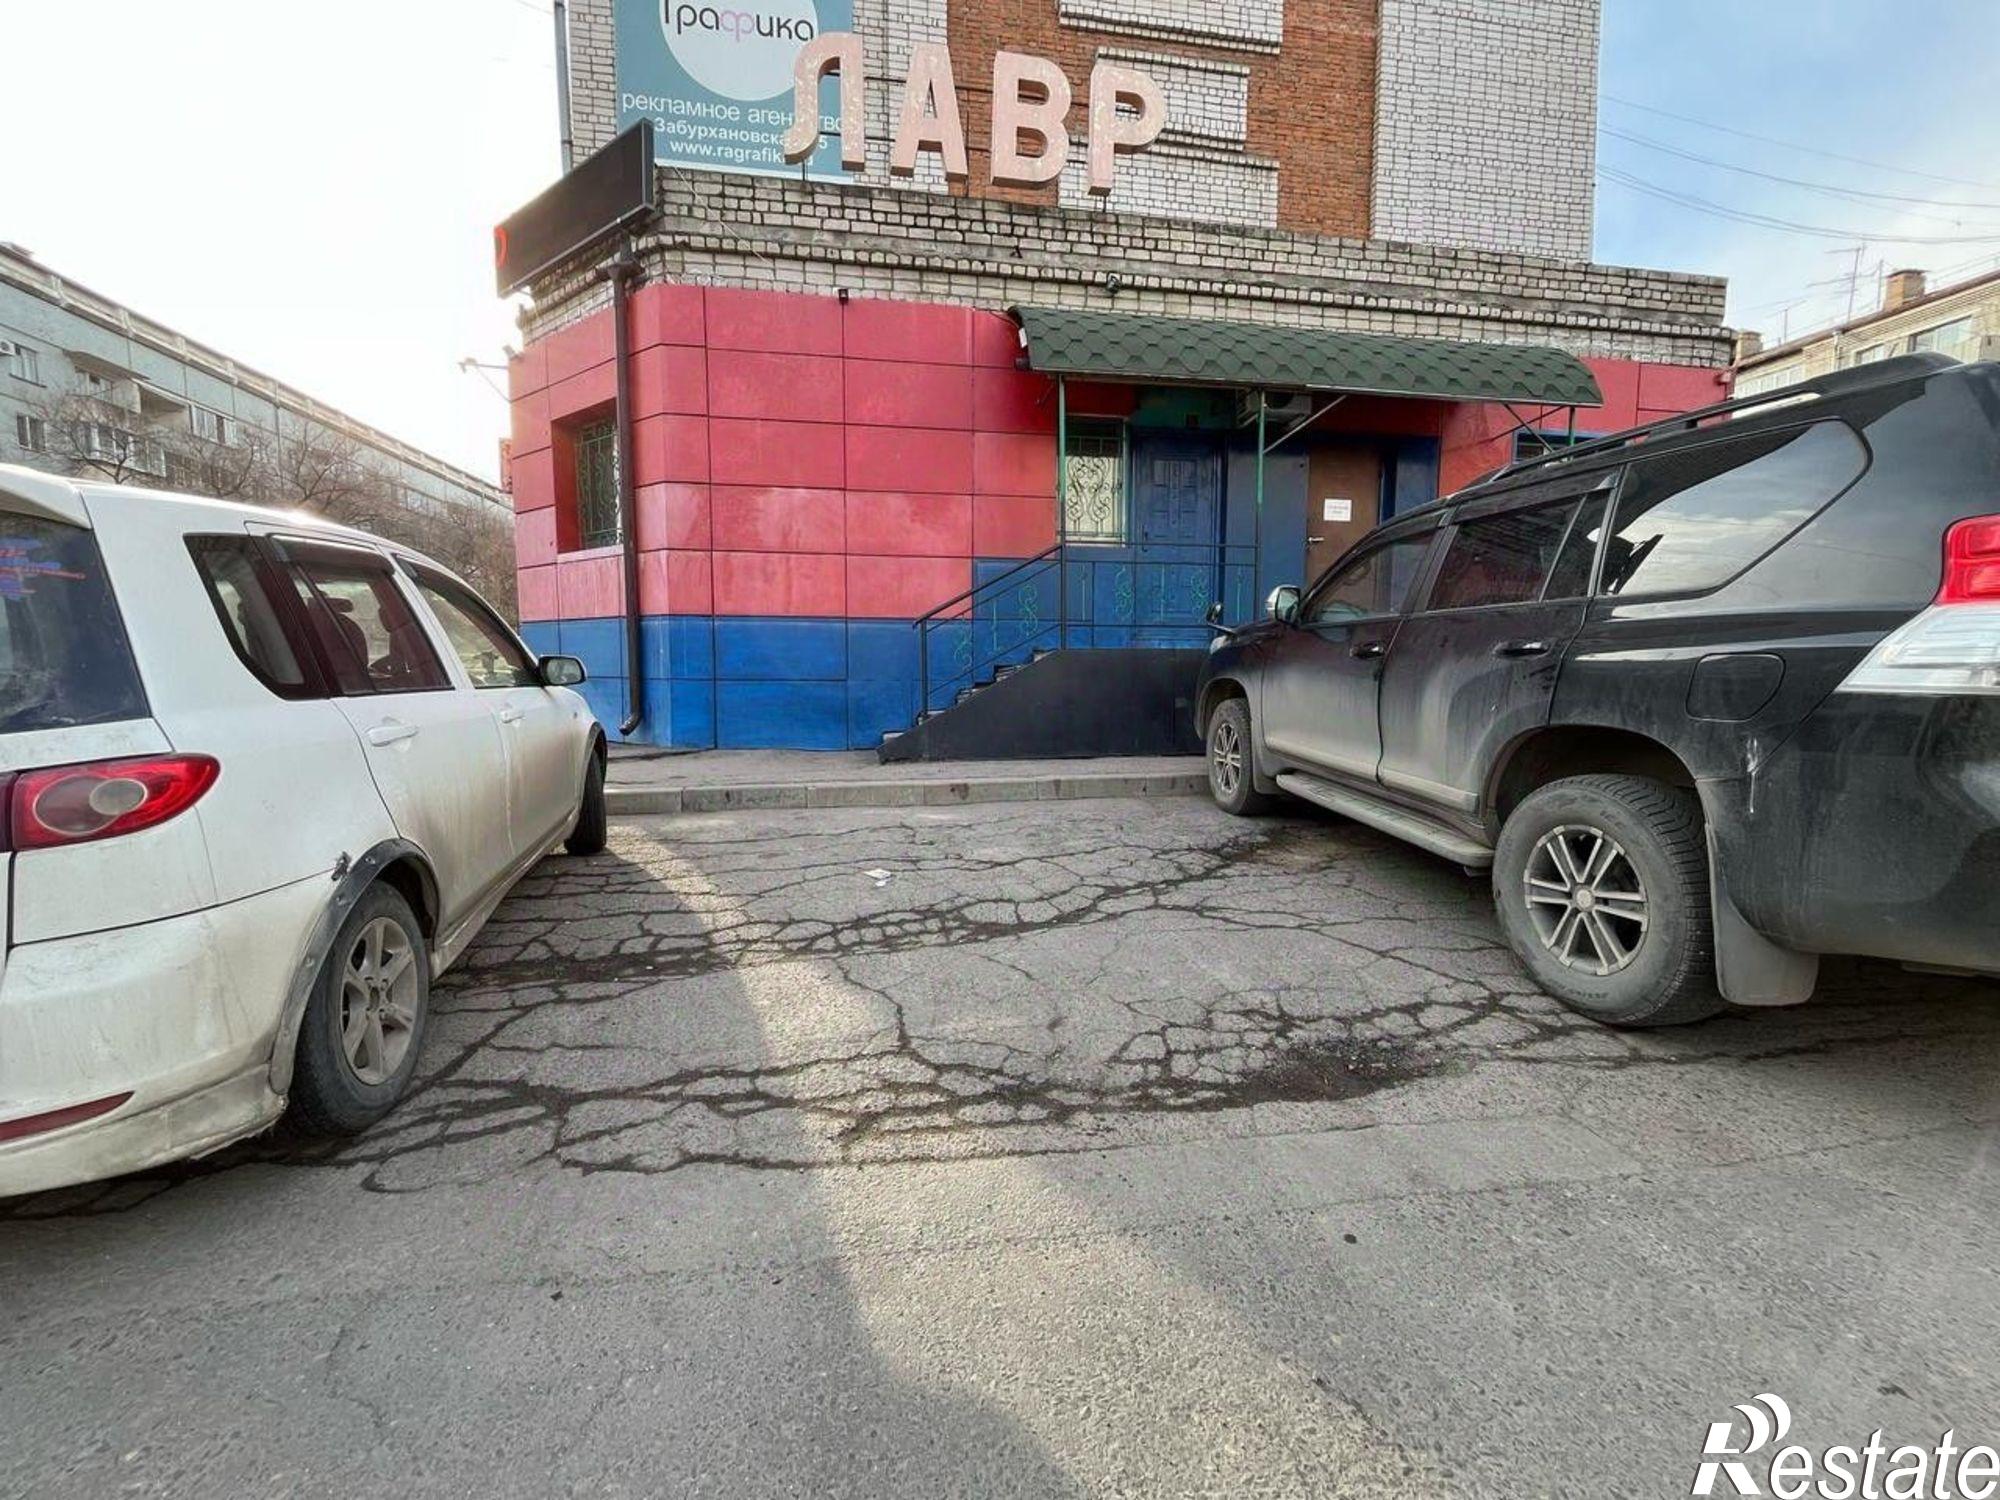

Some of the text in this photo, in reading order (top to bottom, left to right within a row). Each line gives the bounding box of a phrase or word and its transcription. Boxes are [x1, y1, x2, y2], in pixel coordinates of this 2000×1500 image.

[621, 92, 842, 131] рекламное агенво
[784, 31, 1168, 197] ЛАВР
